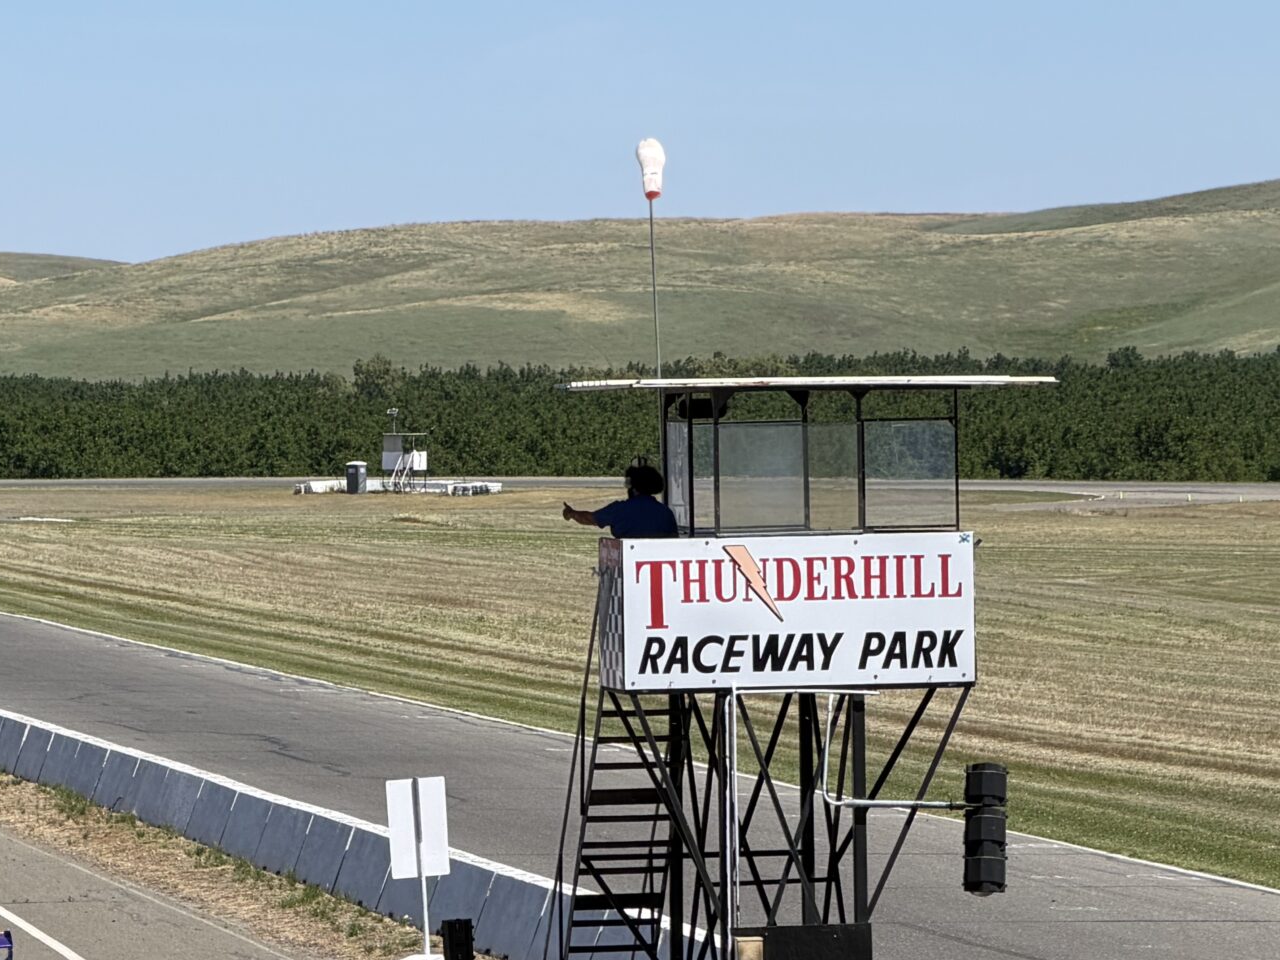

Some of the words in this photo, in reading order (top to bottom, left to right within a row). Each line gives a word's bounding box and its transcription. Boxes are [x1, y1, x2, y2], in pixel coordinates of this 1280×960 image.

[635, 554, 963, 630] THUNDERHILL
[638, 632, 844, 675] RACEWAY
[858, 629, 964, 670] PARK
